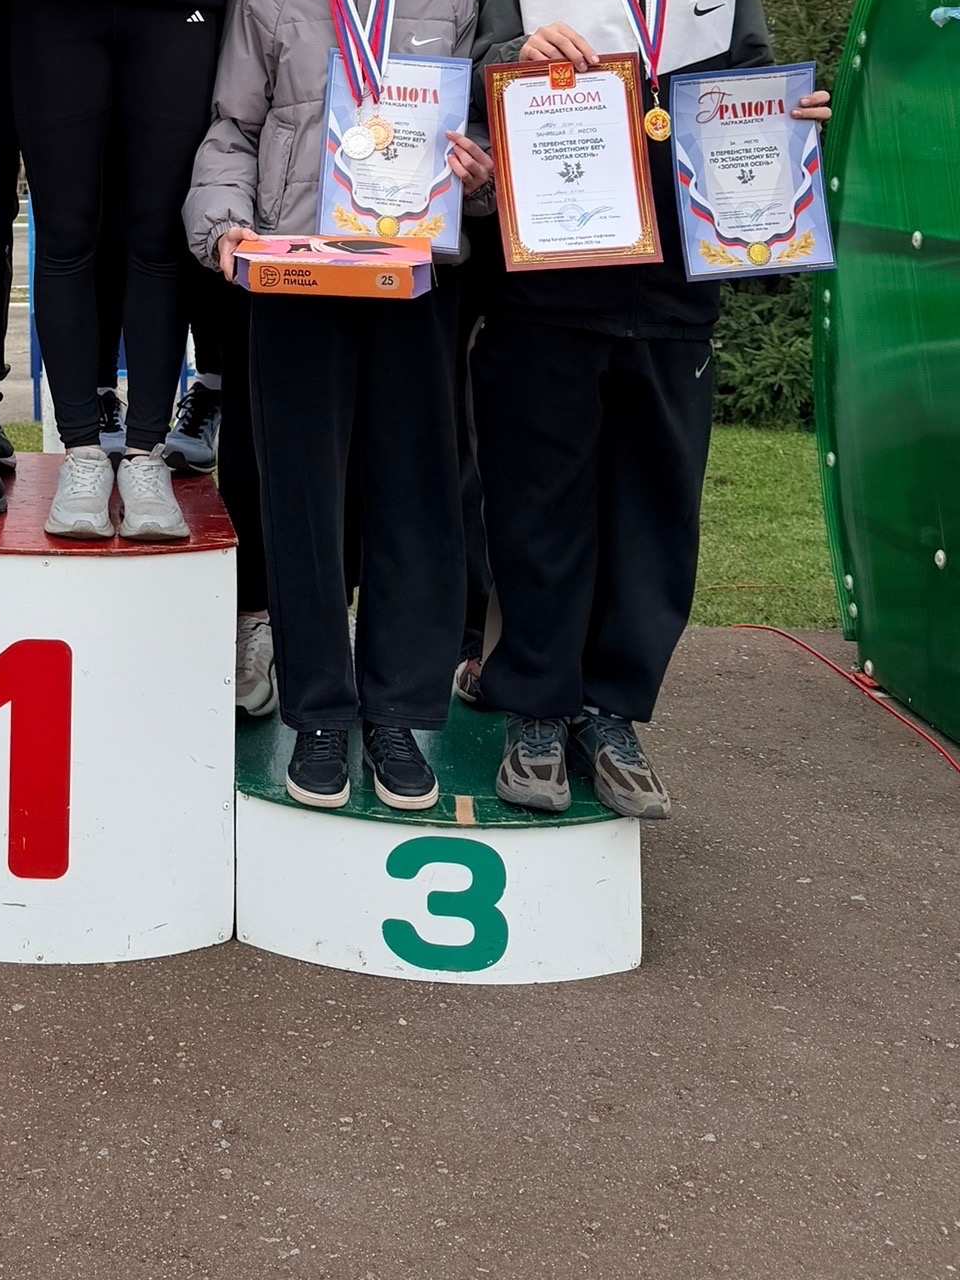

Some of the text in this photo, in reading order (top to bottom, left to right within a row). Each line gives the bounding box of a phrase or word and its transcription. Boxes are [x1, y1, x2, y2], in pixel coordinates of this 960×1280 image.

[529, 91, 602, 108] ДИПЛОМ
[524, 104, 607, 116] НАГРАЖДАЕТСЯ КОМАНДА
[720, 118, 764, 126] НАГРАЖДАЕТСЯ
[536, 130, 566, 138] ЗАНЯВШАЯ
[538, 140, 577, 148] ПЕРВЕНСТВЕ
[543, 146, 590, 154] ЭСТАФЕТНОМУ
[716, 148, 752, 156] ПЕРВЕНСТВЕ
[720, 154, 764, 163] ЭСТАФЕТНОМУ
[283, 269, 312, 277] ДОДО
[283, 278, 318, 286] ПИЦЦА
[382, 276, 394, 286] 25
[382, 837, 508, 970] 3
